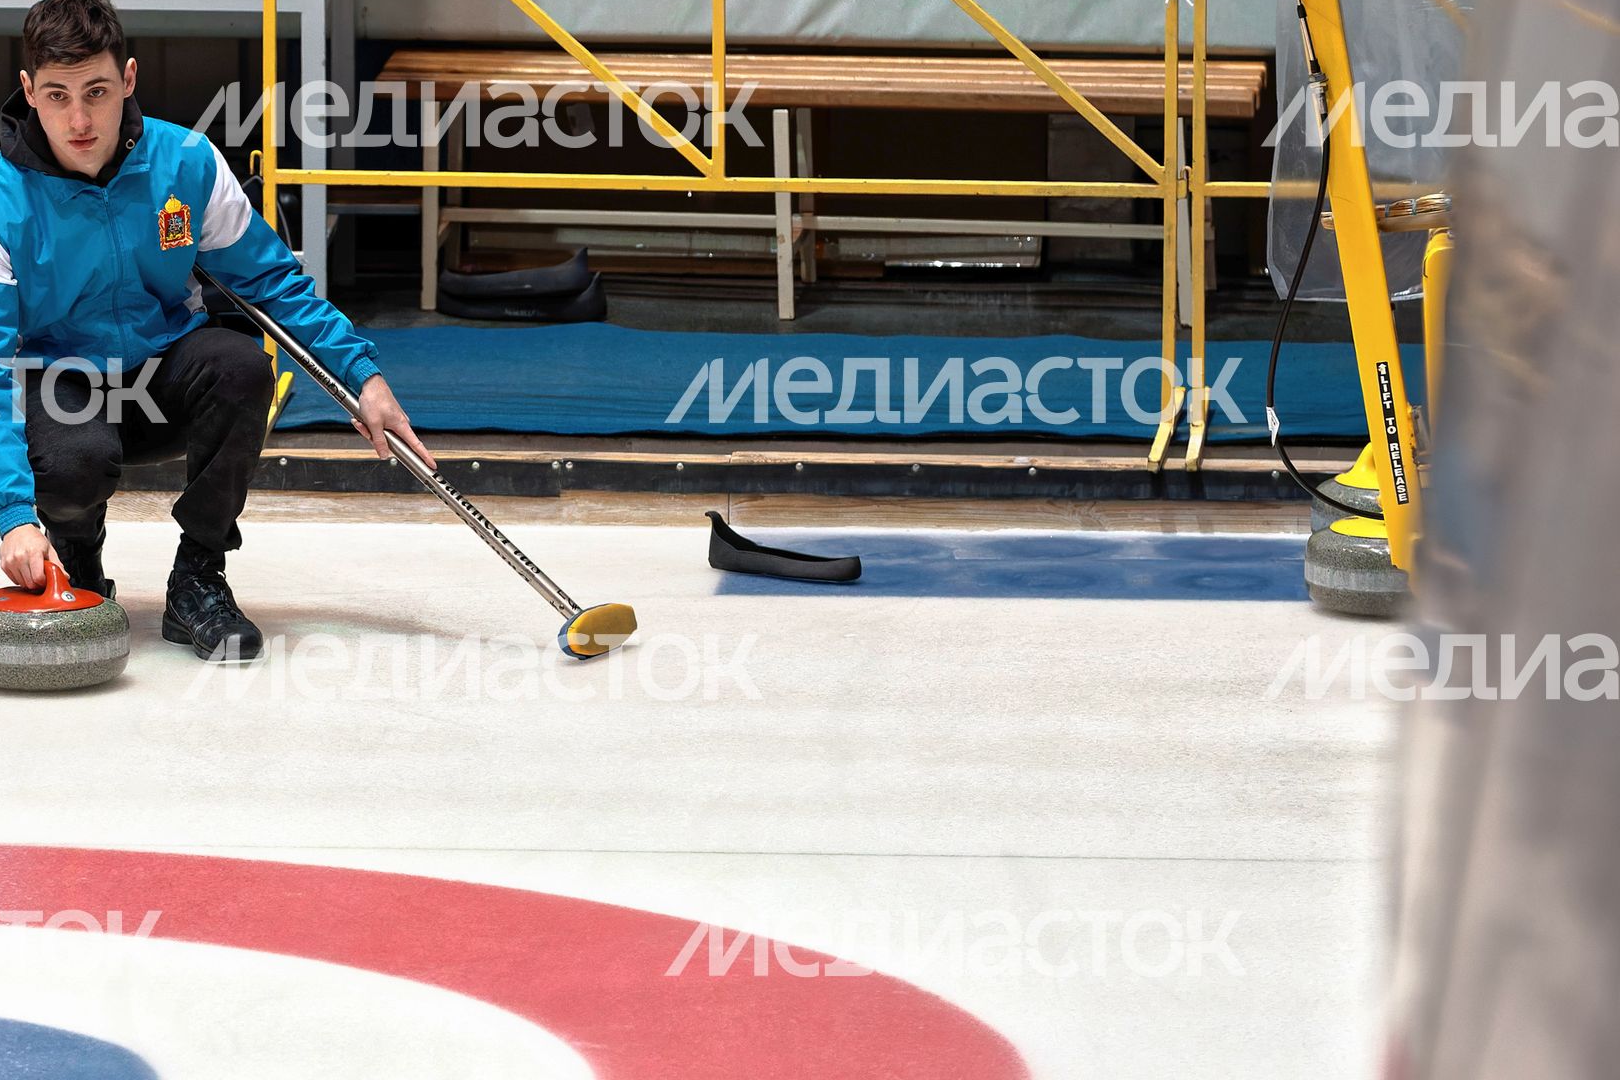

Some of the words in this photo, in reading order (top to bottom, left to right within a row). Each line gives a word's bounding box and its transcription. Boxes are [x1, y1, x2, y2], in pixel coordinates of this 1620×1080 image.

[1379, 375, 1393, 410] LIFT
[1385, 416, 1397, 435] TO
[1389, 442, 1408, 502] RELEASE
